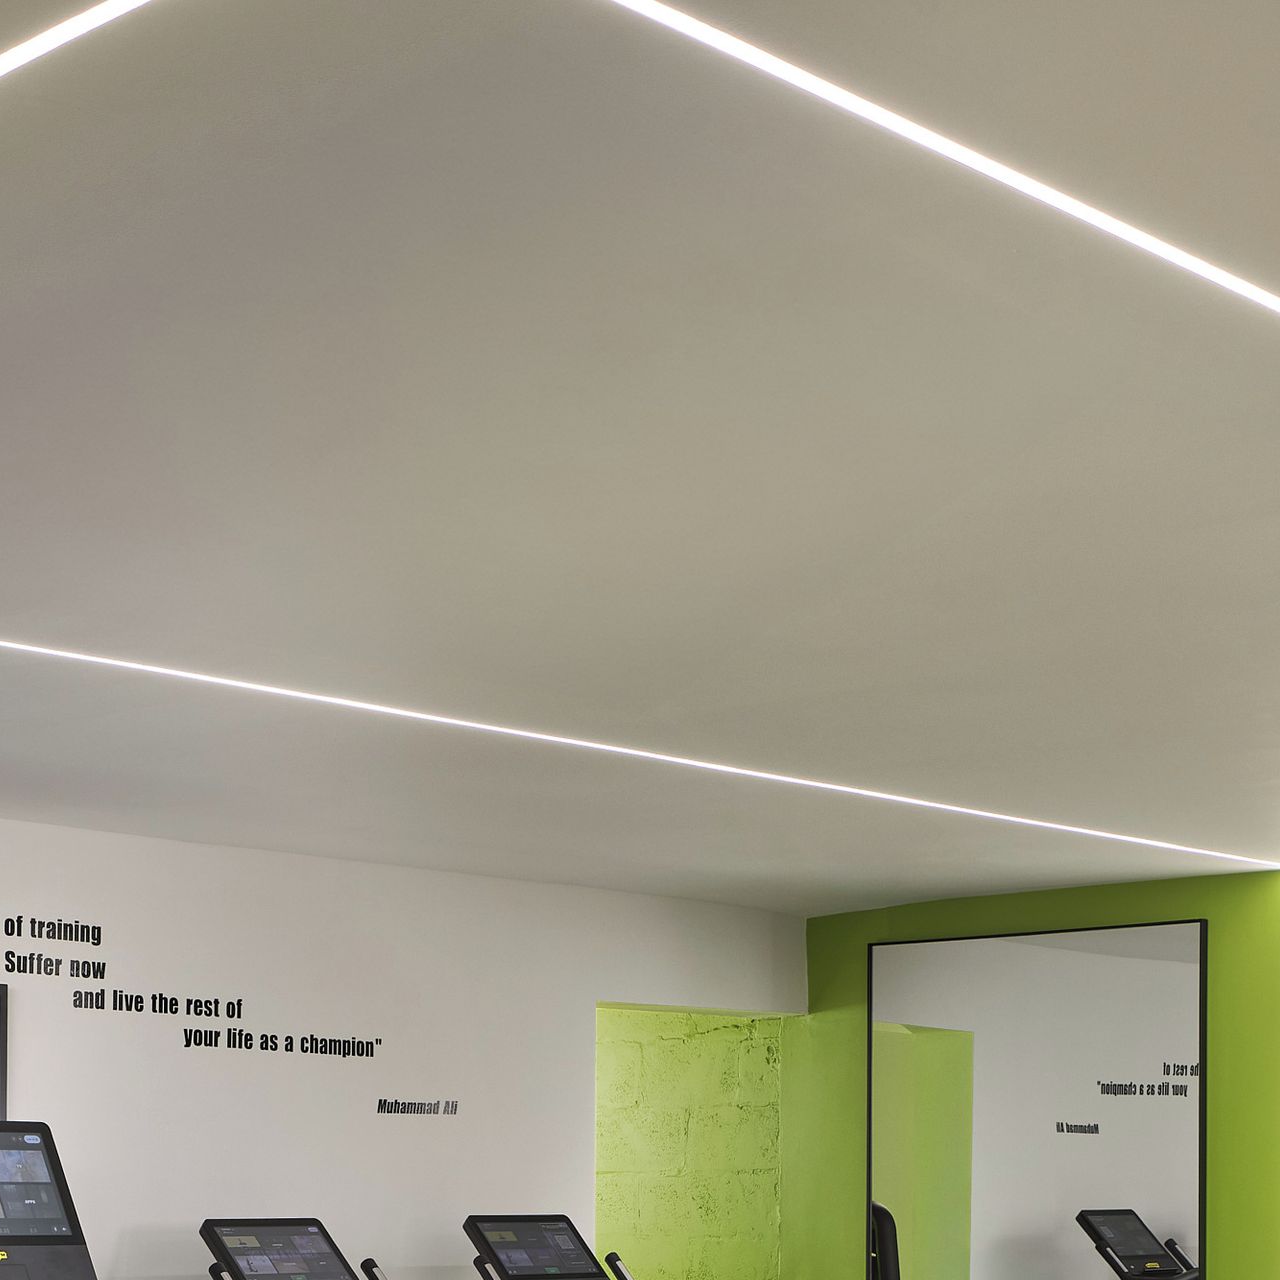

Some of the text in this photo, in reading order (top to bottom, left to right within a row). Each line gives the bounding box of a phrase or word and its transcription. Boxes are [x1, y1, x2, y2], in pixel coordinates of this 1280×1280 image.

[3, 914, 24, 937] of
[29, 917, 103, 947] training
[4, 950, 64, 977] Suffer
[69, 958, 107, 981] now
[72, 988, 244, 1020] and live the rest of
[183, 1027, 383, 1059] your life as a champion"
[377, 1098, 459, 1116] Muhammad Ali
